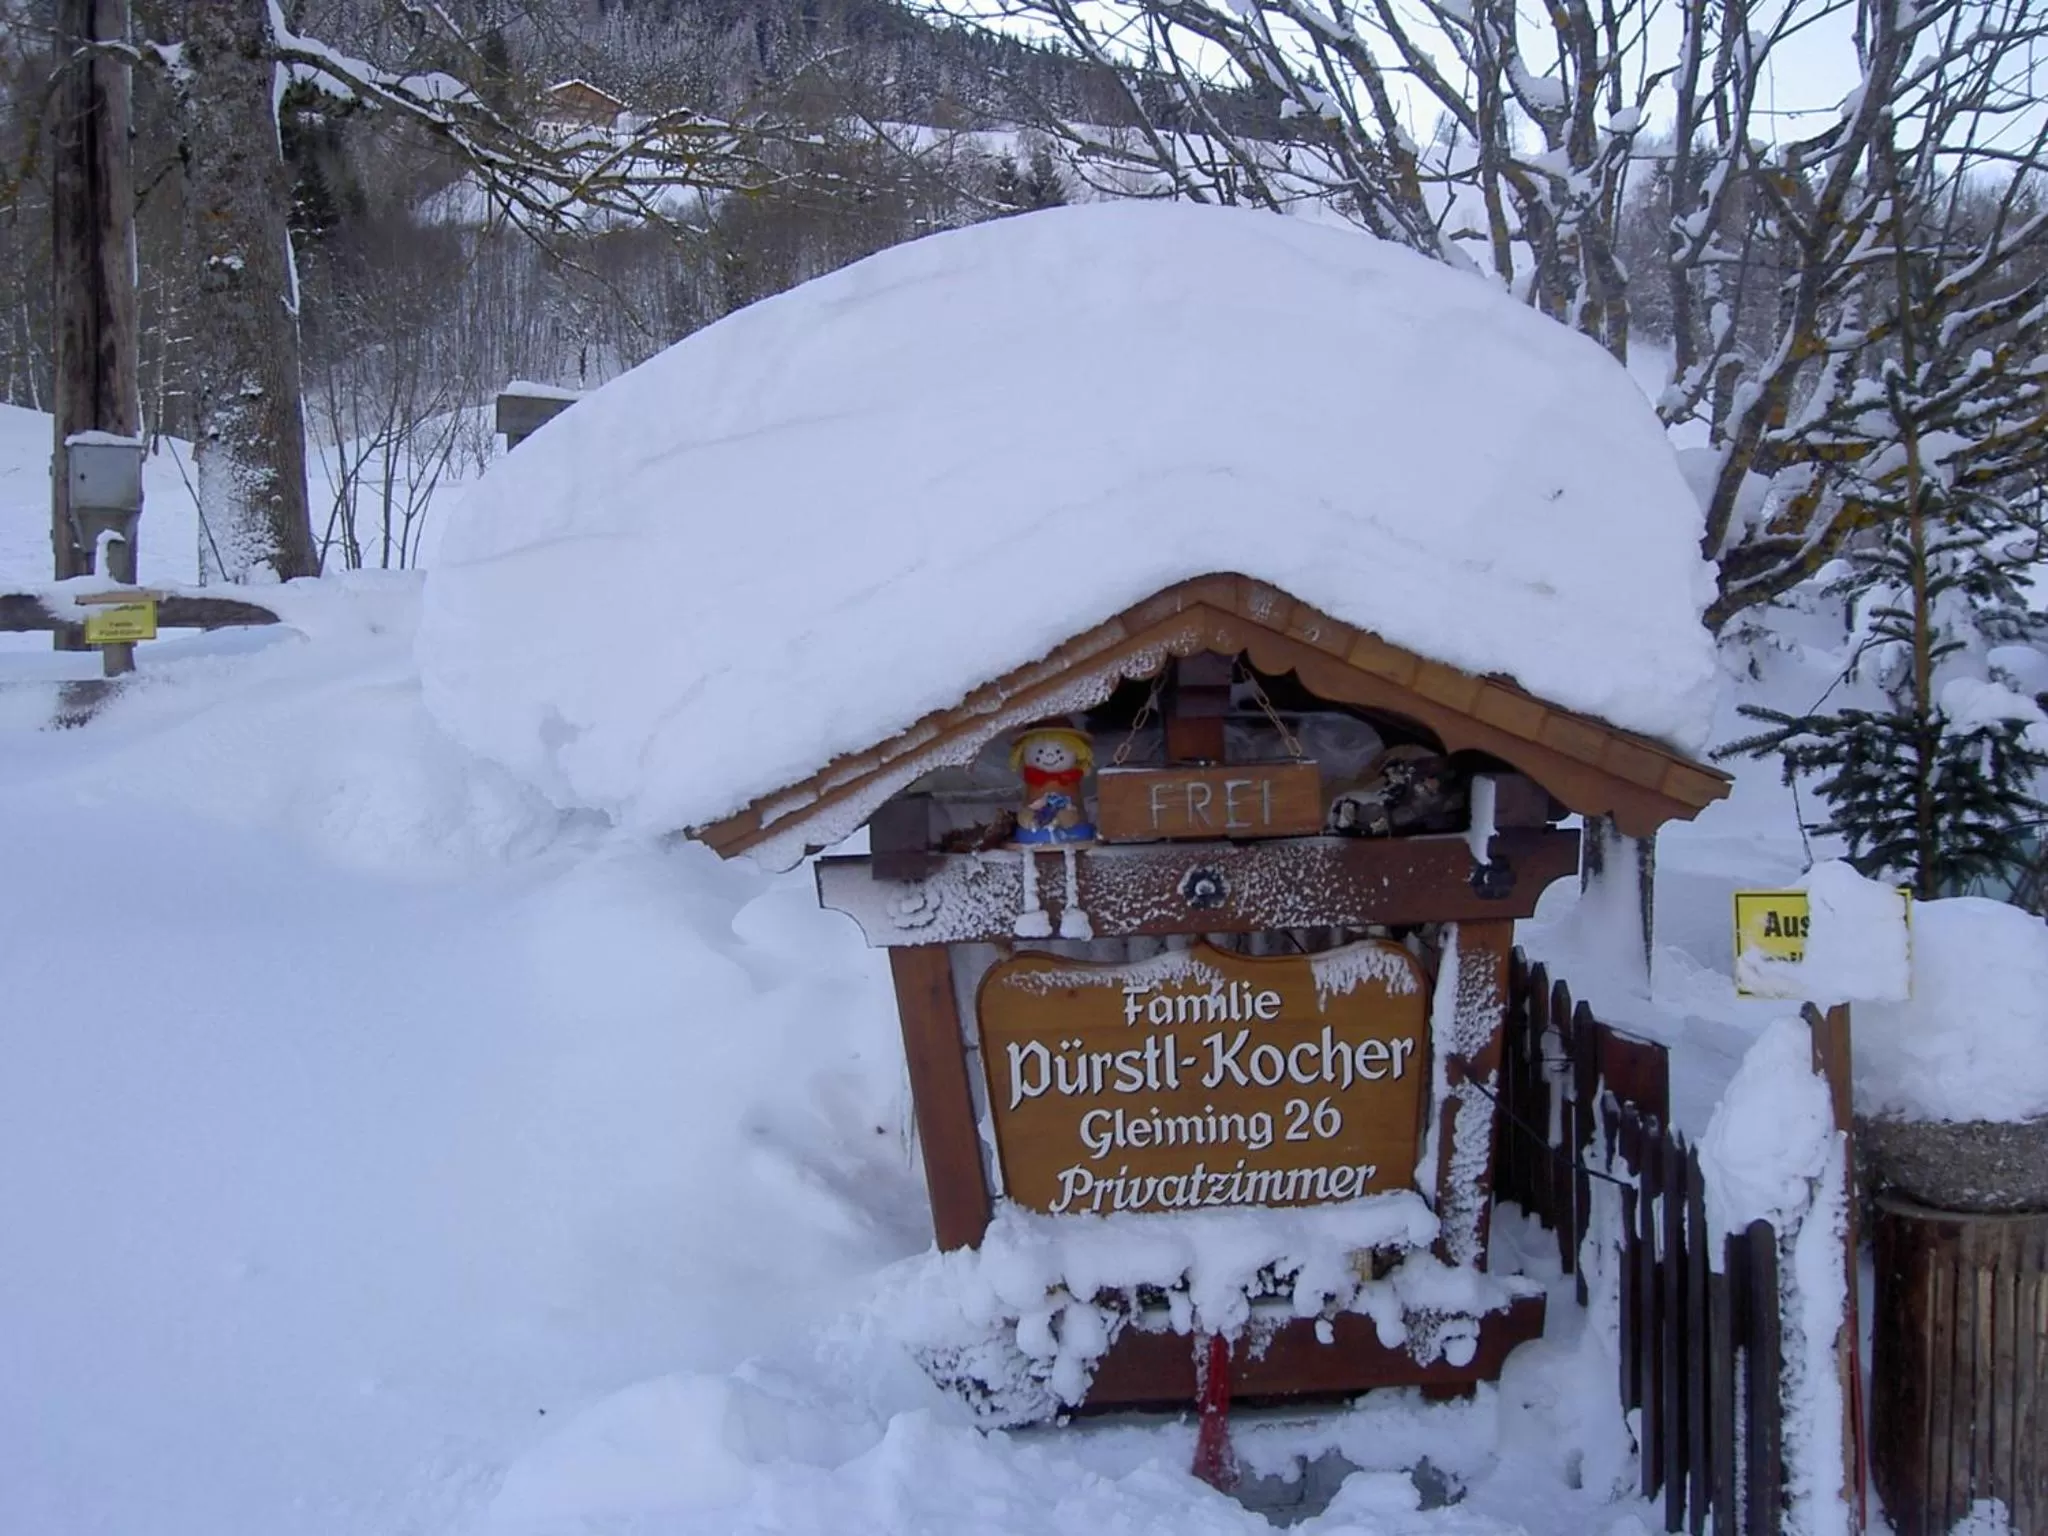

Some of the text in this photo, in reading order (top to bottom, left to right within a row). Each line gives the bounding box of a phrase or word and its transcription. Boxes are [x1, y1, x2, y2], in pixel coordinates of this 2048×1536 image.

[1150, 779, 1272, 829] FREI
[1122, 981, 1281, 1026] Familie
[1006, 1025, 1414, 1109] Pürstl-Kocher
[1080, 1097, 1343, 1158] Gleiming 26
[1049, 1159, 1376, 1213] Privatzimmer
